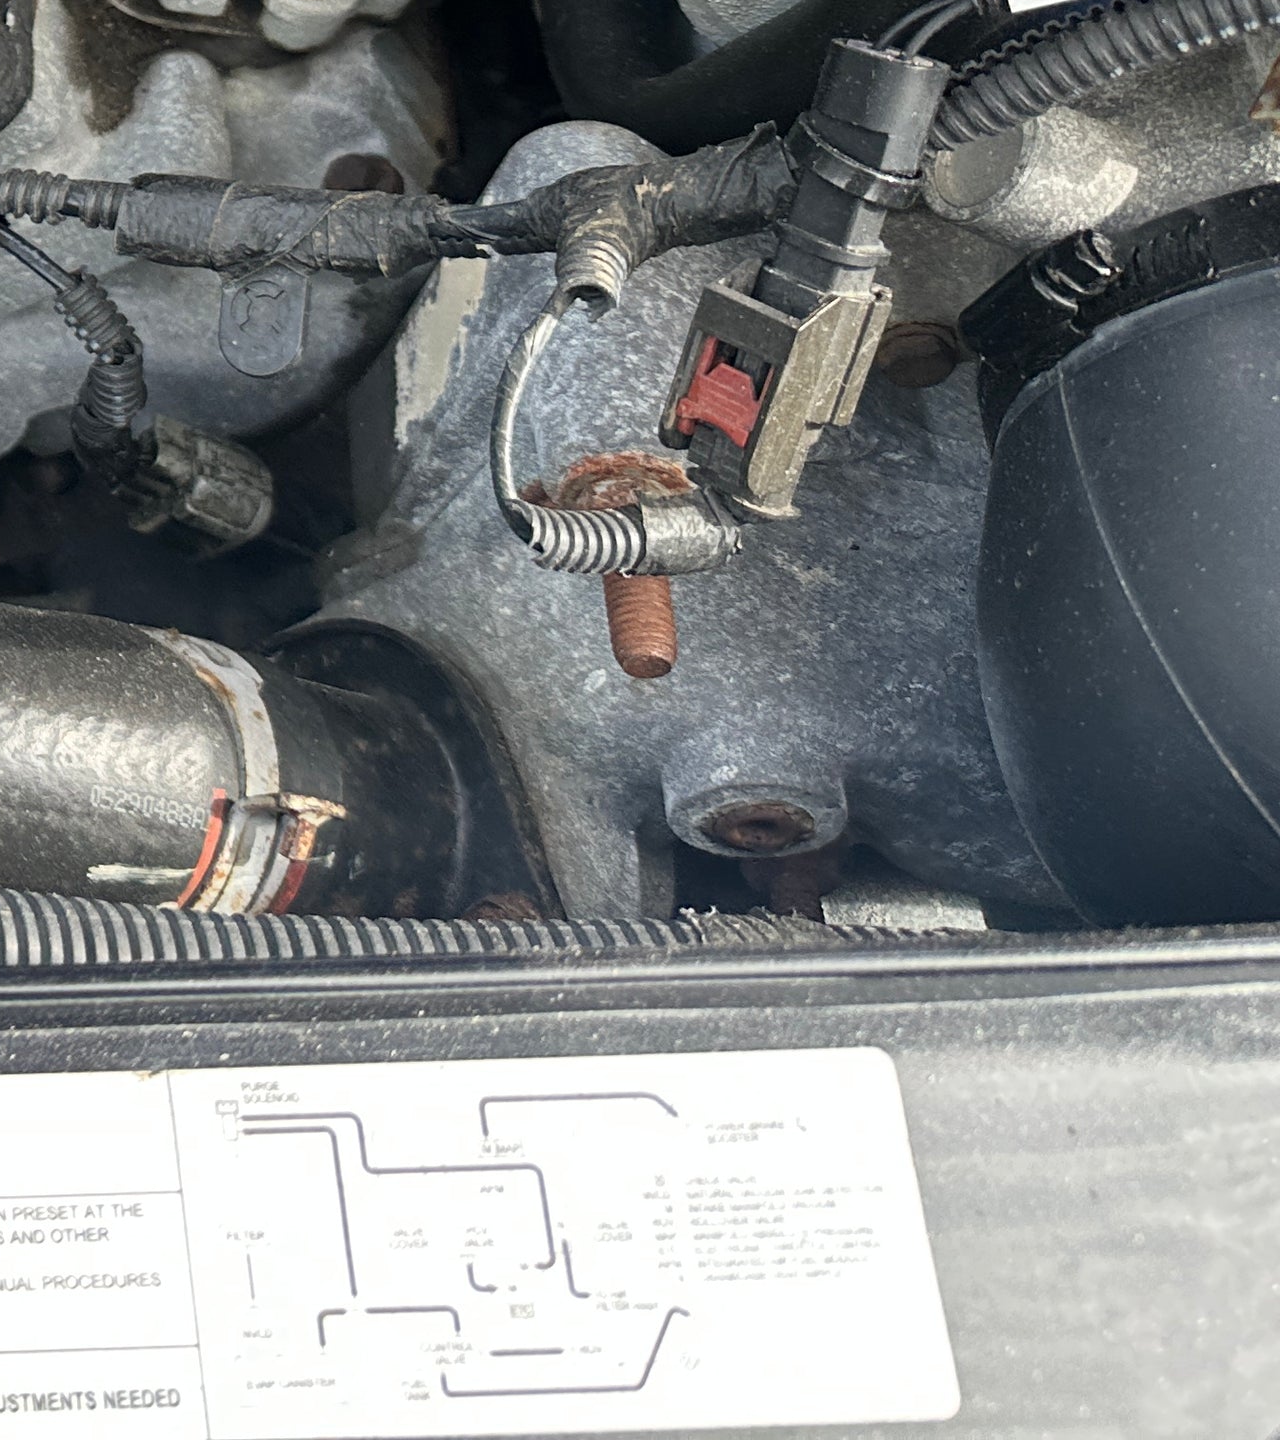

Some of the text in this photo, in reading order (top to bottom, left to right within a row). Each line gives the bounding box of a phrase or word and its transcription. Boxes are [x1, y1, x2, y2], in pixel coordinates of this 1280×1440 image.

[13, 1205, 77, 1223] PRESET
[85, 1204, 104, 1221] AT
[112, 1203, 143, 1221] THE
[10, 1229, 45, 1247] AND
[51, 1227, 108, 1246] OTHER
[43, 1272, 161, 1293] PROCEDURES
[104, 1387, 180, 1411] NEEDED
